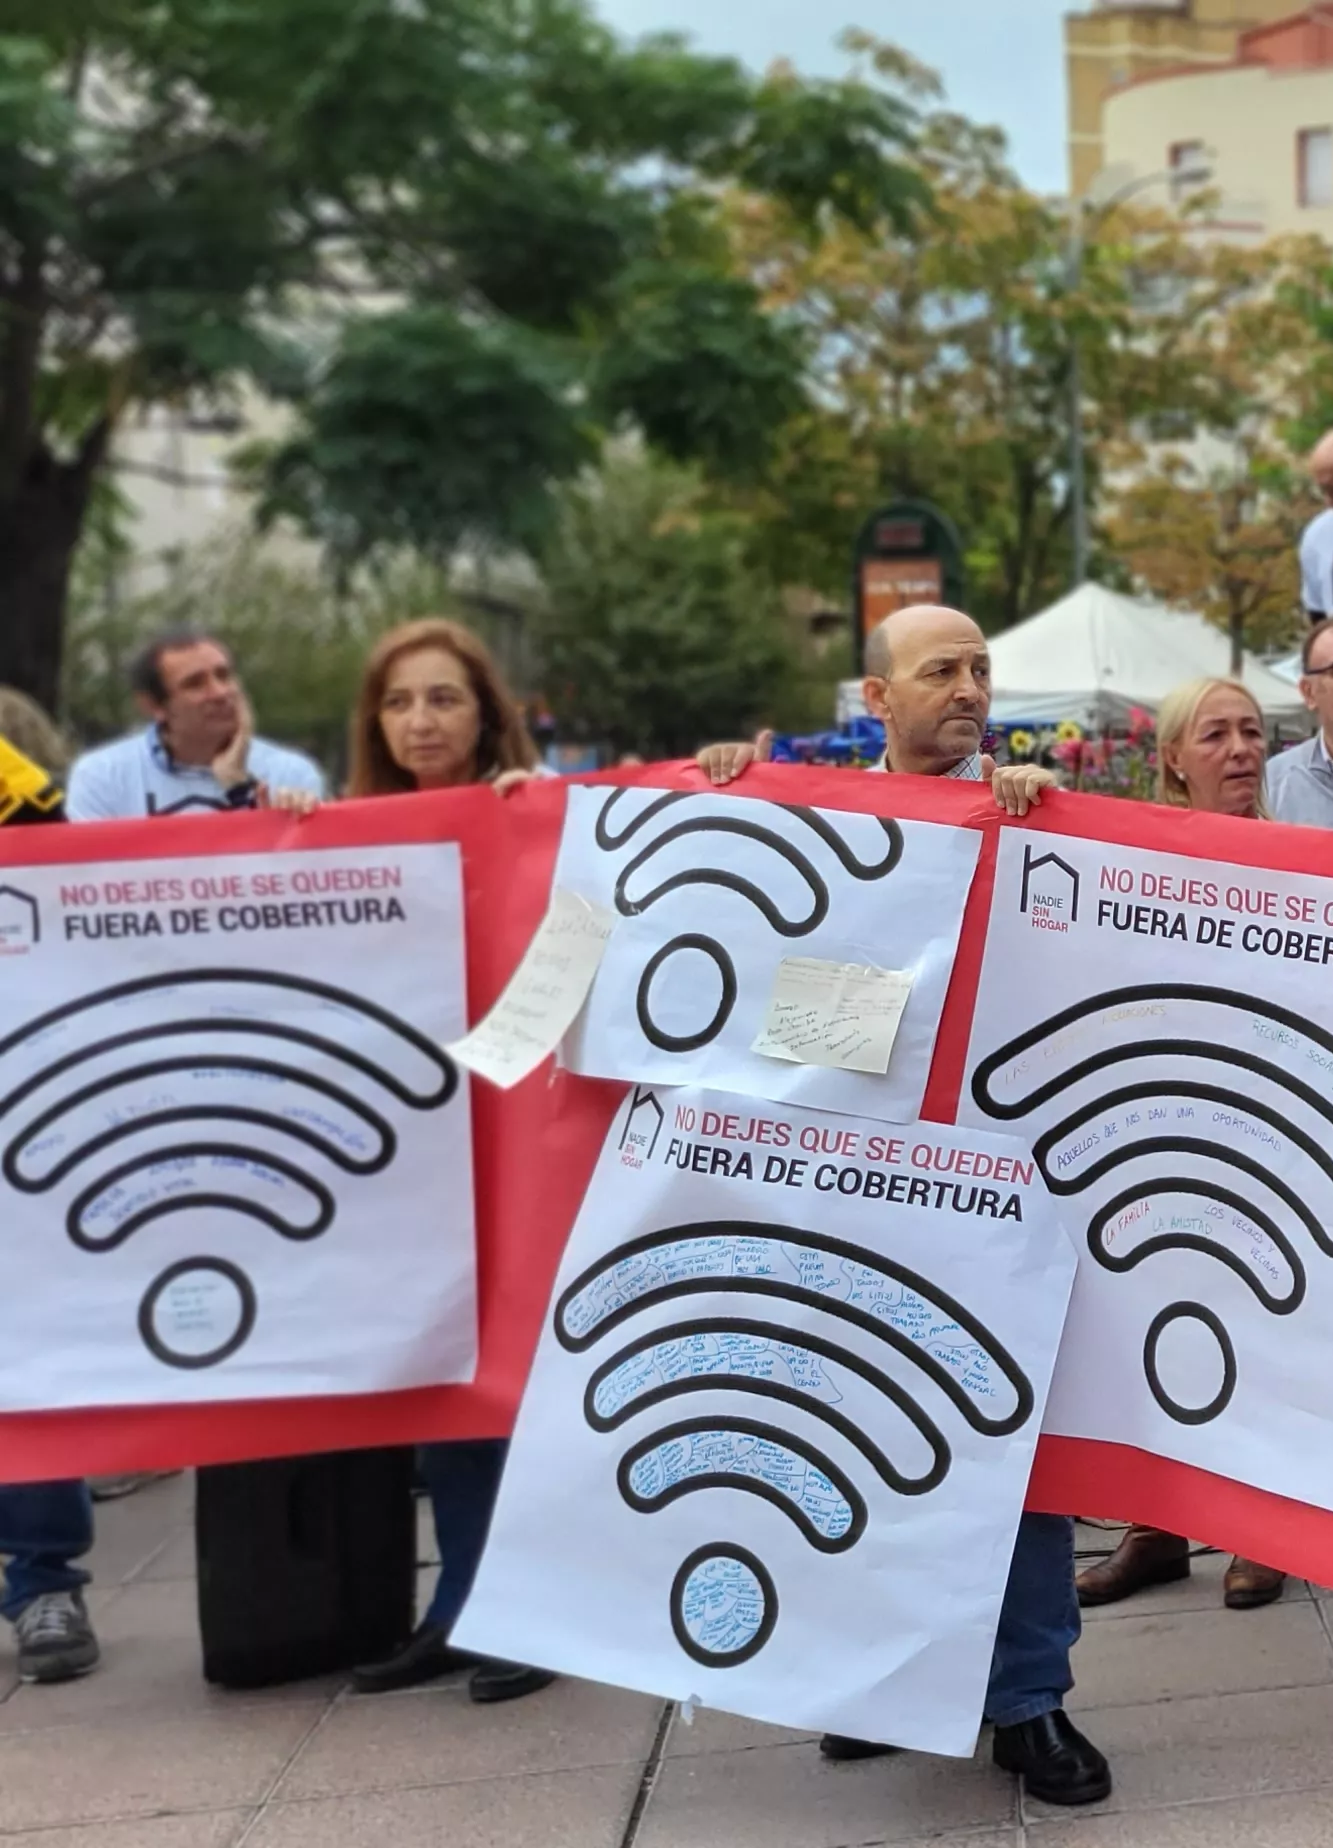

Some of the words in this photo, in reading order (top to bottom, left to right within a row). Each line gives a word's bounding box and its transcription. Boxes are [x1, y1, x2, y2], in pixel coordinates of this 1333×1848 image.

[61, 884, 99, 908] NO
[104, 878, 184, 905] DEJES
[191, 876, 245, 900] QUE
[251, 873, 285, 897] SE
[291, 866, 402, 895] QUEDEN
[1033, 893, 1063, 909] NADIE
[1100, 865, 1134, 893] NO
[1141, 872, 1218, 907] DEJES
[1226, 886, 1278, 917] QUE
[1284, 895, 1317, 924] SE
[64, 911, 163, 940] FUERA
[170, 908, 210, 934] DE
[218, 897, 406, 932] COBERTURA
[1031, 919, 1069, 933] HOGAR
[1032, 905, 1050, 918] SIN
[1098, 899, 1188, 942] FUERA
[1196, 915, 1236, 949] DE
[1252, 1019, 1299, 1049] RECURSOS
[629, 1132, 648, 1147] NADIE
[674, 1104, 696, 1132] NO
[701, 1111, 792, 1147] DEJES
[799, 1126, 860, 1157] QUE
[865, 1136, 905, 1164] SE
[911, 1143, 1034, 1185] QUEDEN
[1057, 1133, 1100, 1170] AQUELLOS
[1104, 1122, 1119, 1138] QUE
[1125, 1111, 1141, 1128] NOS
[1148, 1107, 1167, 1120] DAN
[1176, 1106, 1194, 1119] UNA
[1212, 1111, 1282, 1152] OPORTUNIDAD
[620, 1154, 643, 1170] HOGAR
[664, 1138, 753, 1180] FUERA
[762, 1155, 809, 1187] DE
[814, 1163, 1023, 1222] COBERTURA
[1105, 1227, 1115, 1246] LA
[1170, 1216, 1213, 1235] AMISTAD
[1204, 1204, 1225, 1220] LOS
[1231, 1215, 1264, 1244] VECINOS
